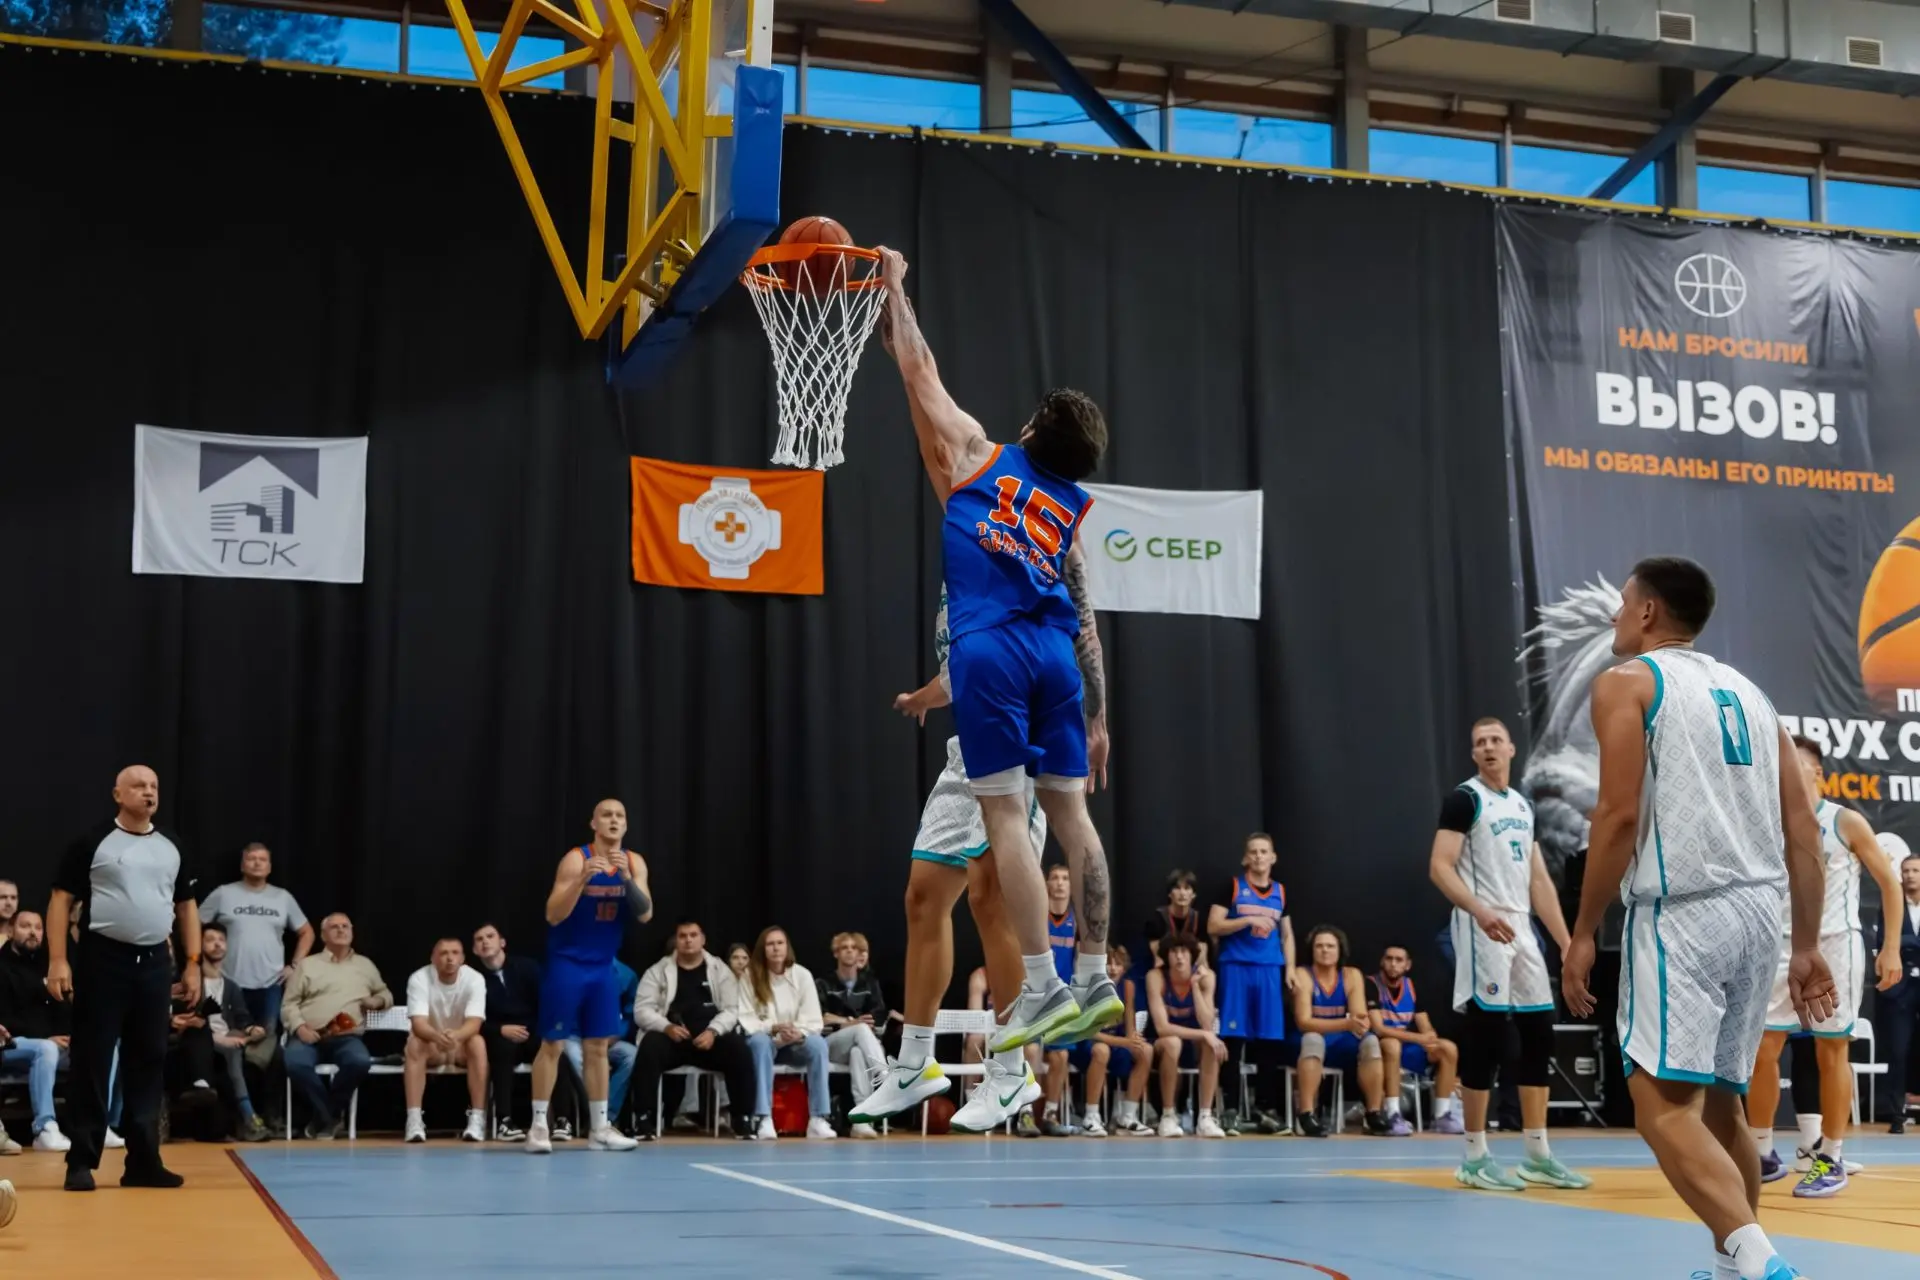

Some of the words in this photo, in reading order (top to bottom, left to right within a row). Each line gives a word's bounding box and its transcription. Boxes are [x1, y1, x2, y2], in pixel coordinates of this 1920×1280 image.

[1618, 327, 1678, 352] НАМ
[1685, 333, 1808, 364] БРОСИЛИ
[1596, 372, 1838, 445] ВЫЗОВ!
[1544, 447, 1590, 470] МЫ
[1595, 451, 1720, 480] ОБЯЗАНЫ
[1725, 461, 1770, 485] ЕГО
[1775, 466, 1895, 494] ПРИНЯТЬ!
[212, 538, 301, 567] ТСК
[1146, 537, 1222, 560] СБЕР
[1708, 688, 1753, 767] 0
[1820, 771, 1882, 801] МСК
[232, 905, 280, 918] adidas
